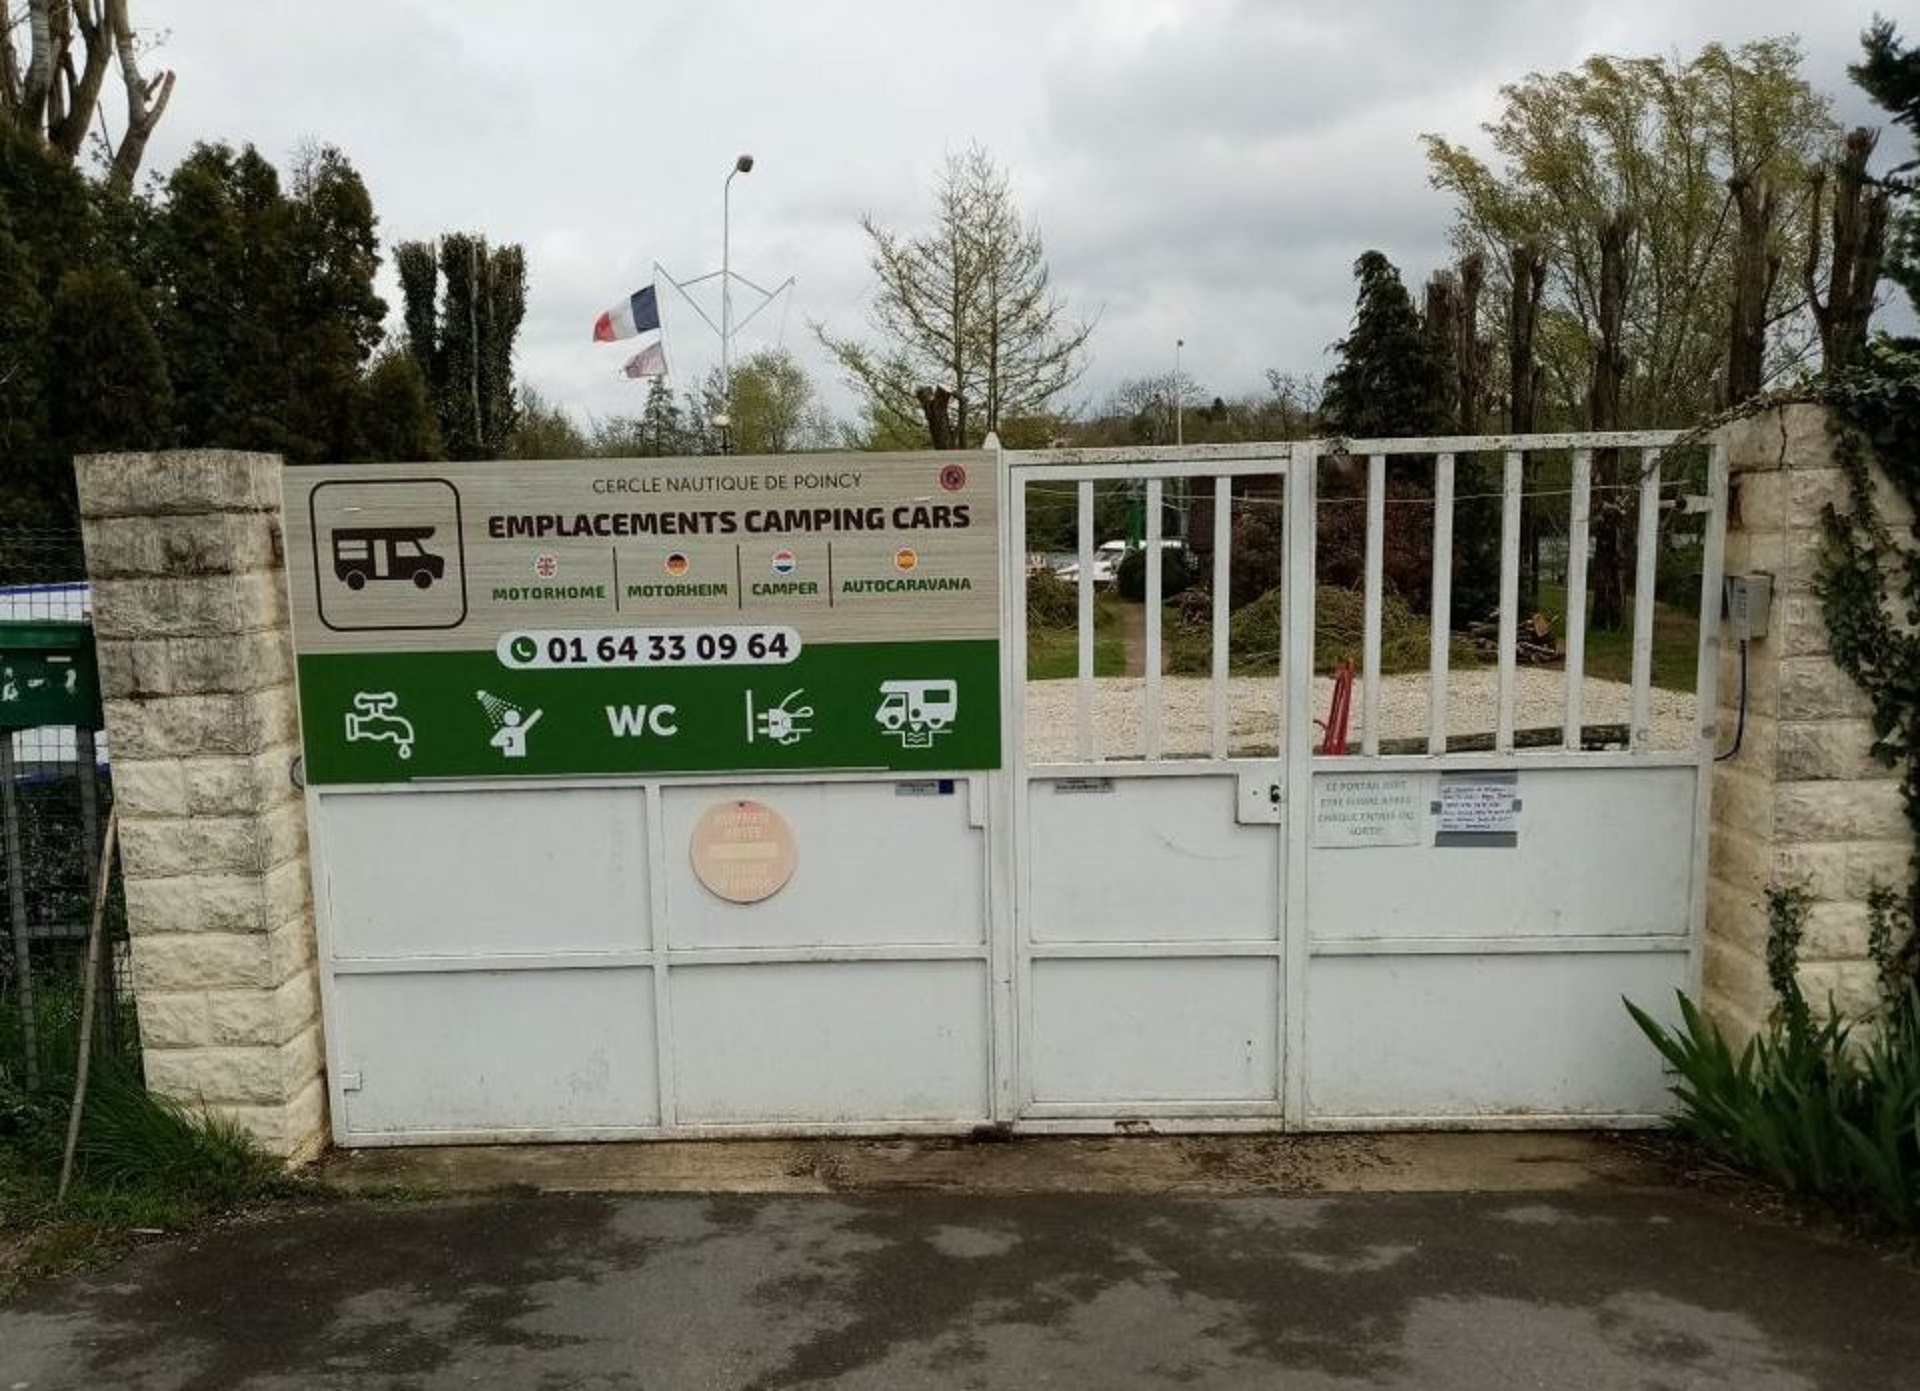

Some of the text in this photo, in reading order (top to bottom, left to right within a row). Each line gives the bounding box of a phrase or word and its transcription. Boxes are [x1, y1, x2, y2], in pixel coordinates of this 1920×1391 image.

[592, 473, 863, 494] CERCLE NAUTIQUE DE POINCY
[488, 505, 971, 538] EMPLACEMENTS CAMPING CARS
[492, 586, 606, 600] MOTORHOME
[627, 584, 728, 598] MOTORHEIM
[752, 582, 818, 596] CAMPER
[842, 578, 972, 593] AUTOCARAVANA
[548, 633, 789, 663] 01 64 33 09 64
[606, 704, 678, 737] WC
